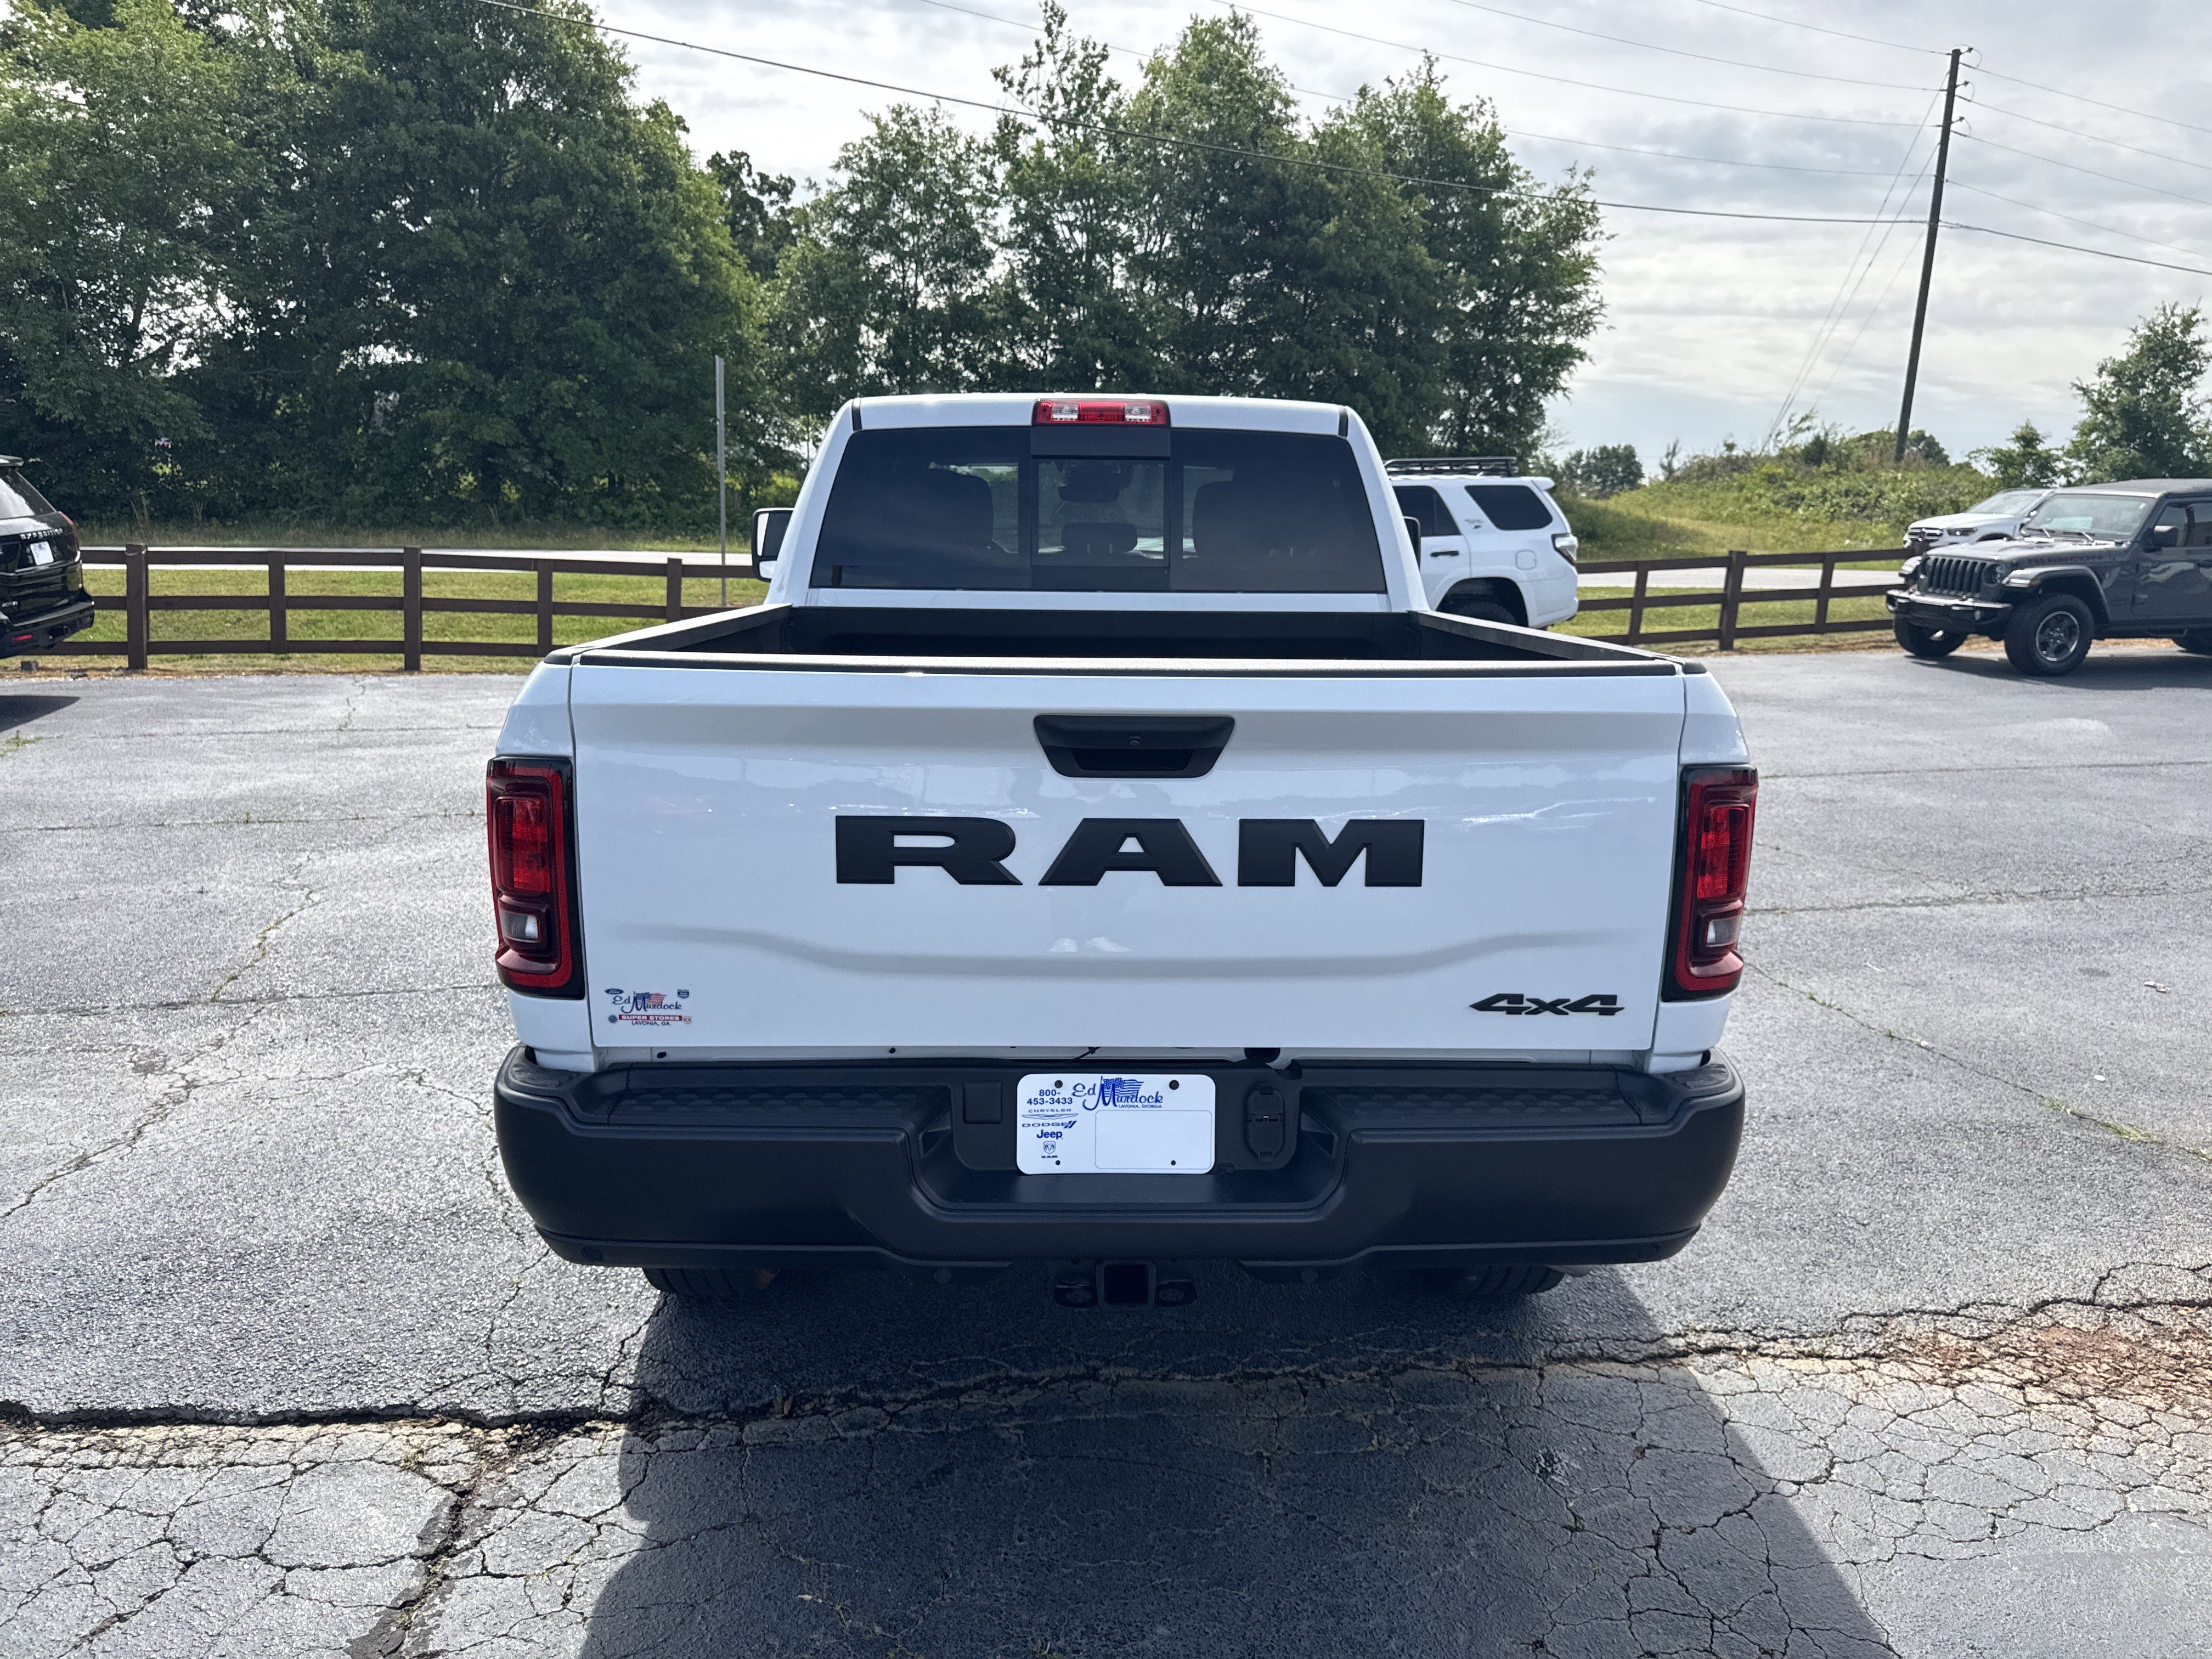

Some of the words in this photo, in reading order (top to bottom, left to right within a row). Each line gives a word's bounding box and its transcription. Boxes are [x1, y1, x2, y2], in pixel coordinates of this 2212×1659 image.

[836, 815, 1425, 887] RAM
[612, 996, 631, 1005] Ed
[621, 991, 681, 1013] Murdock
[1469, 994, 1624, 1015] 4x4
[1071, 1083, 1096, 1097] Ed
[1082, 1076, 1164, 1110] Murdock
[1036, 1129, 1063, 1140] Jeep
